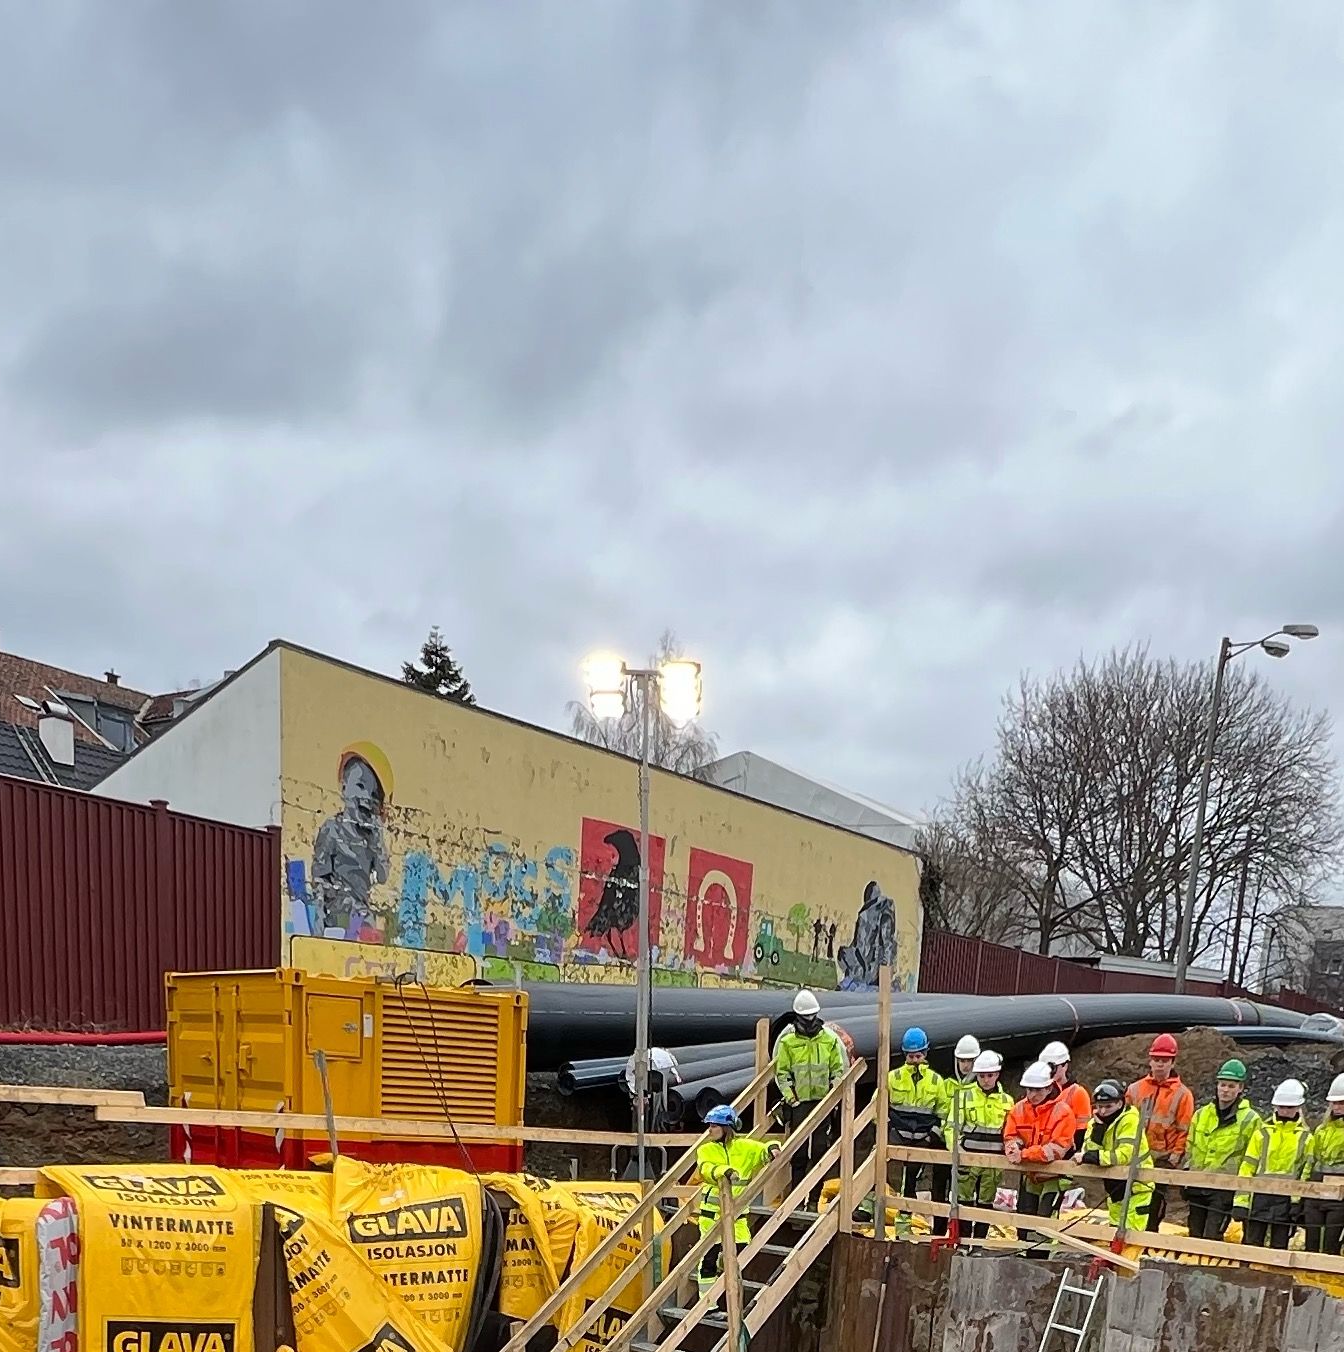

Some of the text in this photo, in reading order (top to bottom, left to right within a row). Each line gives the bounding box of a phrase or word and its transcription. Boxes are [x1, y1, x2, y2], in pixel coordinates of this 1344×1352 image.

[94, 1176, 217, 1196] GLAVA
[118, 1192, 217, 1207] ISOLASJON
[109, 1213, 235, 1236] VINTERMATTE
[354, 1206, 462, 1237] GLAVA
[368, 1243, 457, 1260] ISOLASJON
